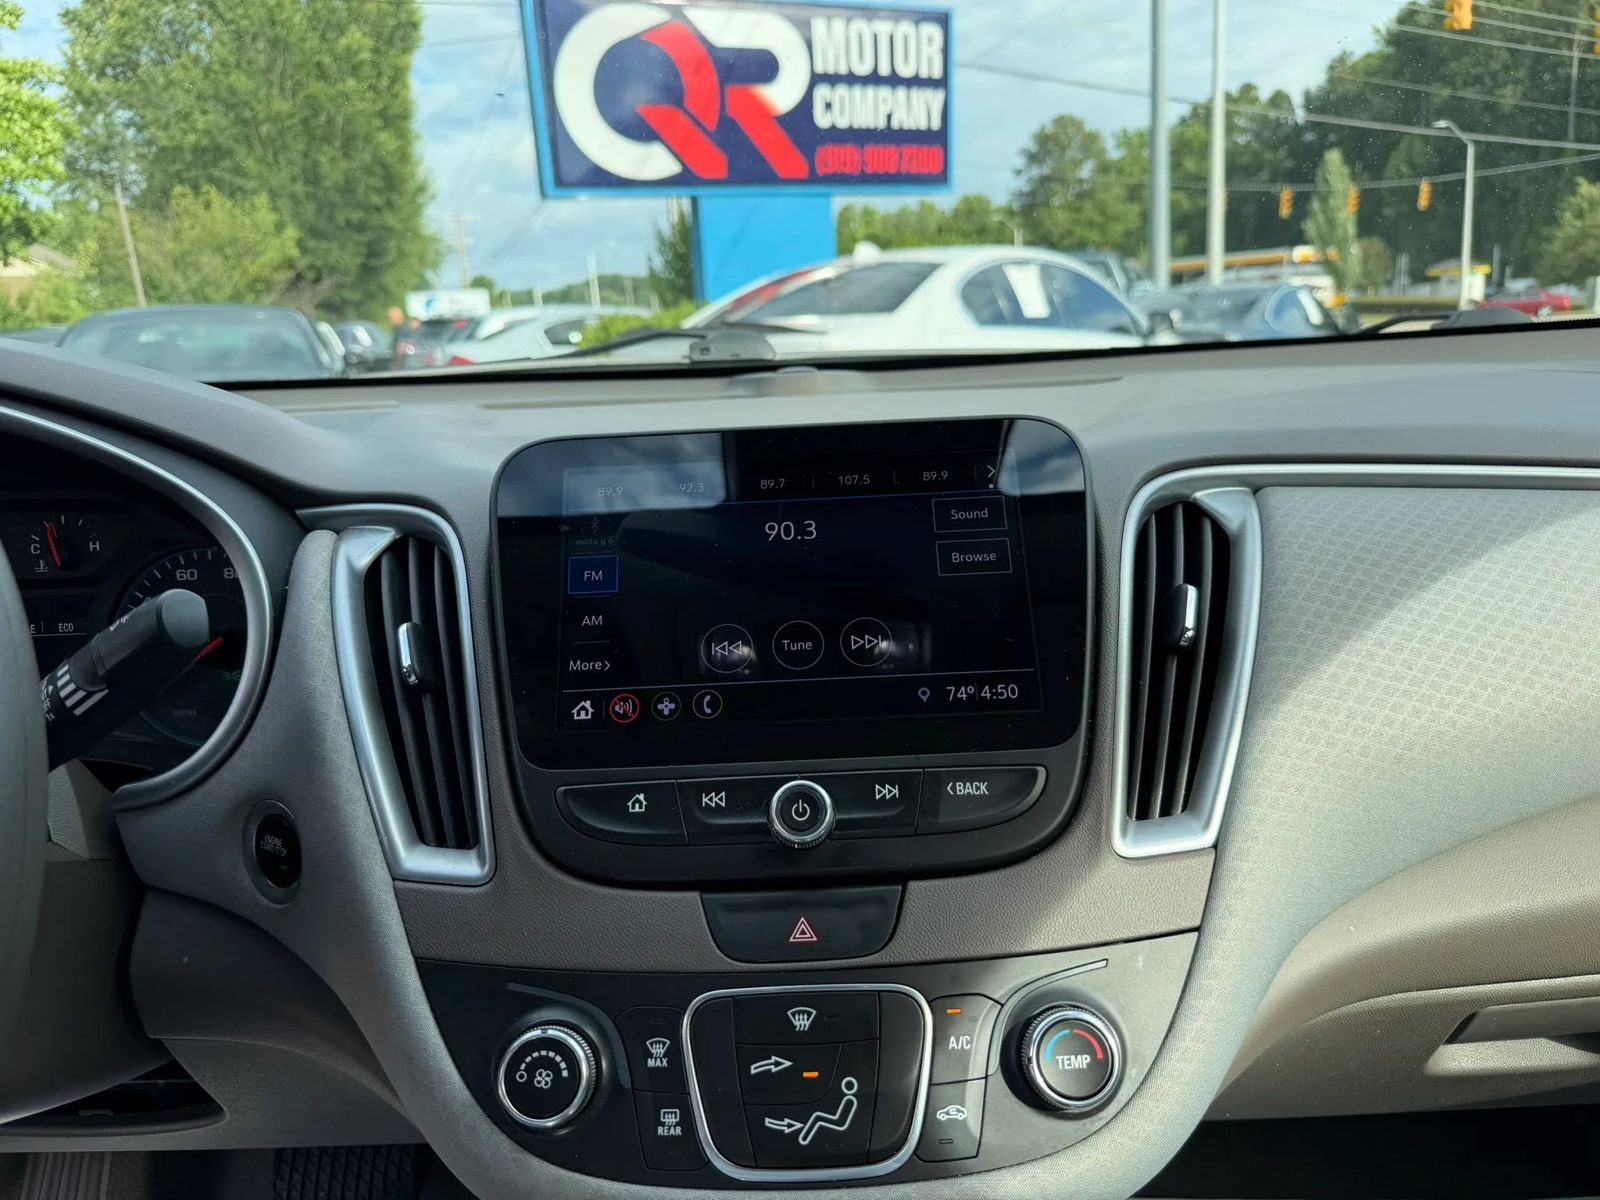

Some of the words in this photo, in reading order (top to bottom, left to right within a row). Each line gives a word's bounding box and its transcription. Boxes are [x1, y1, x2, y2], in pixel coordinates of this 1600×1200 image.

[810, 15, 945, 79] MOTOR
[812, 82, 947, 131] COMPANY
[838, 474, 871, 486] 107.5
[922, 470, 949, 482] 89.9
[679, 483, 705, 493] 92.3
[760, 478, 786, 490] 89.7
[598, 486, 624, 497] 89.9
[950, 507, 989, 520] Sound
[764, 520, 818, 542] 90.3
[89, 541, 100, 552] H
[951, 551, 997, 564] Browse
[176, 569, 198, 581] 60
[223, 567, 239, 579] 8
[583, 570, 603, 582] FM
[581, 615, 603, 627] AM
[58, 622, 74, 633] ECO
[782, 639, 813, 652] Tune
[568, 660, 603, 672] More
[980, 684, 1019, 701] 4:50
[955, 782, 989, 796] BACK
[948, 1035, 971, 1050] A/C
[647, 1057, 668, 1068] MAX
[1055, 1054, 1091, 1071] TEMP
[657, 1126, 682, 1137] REAR
